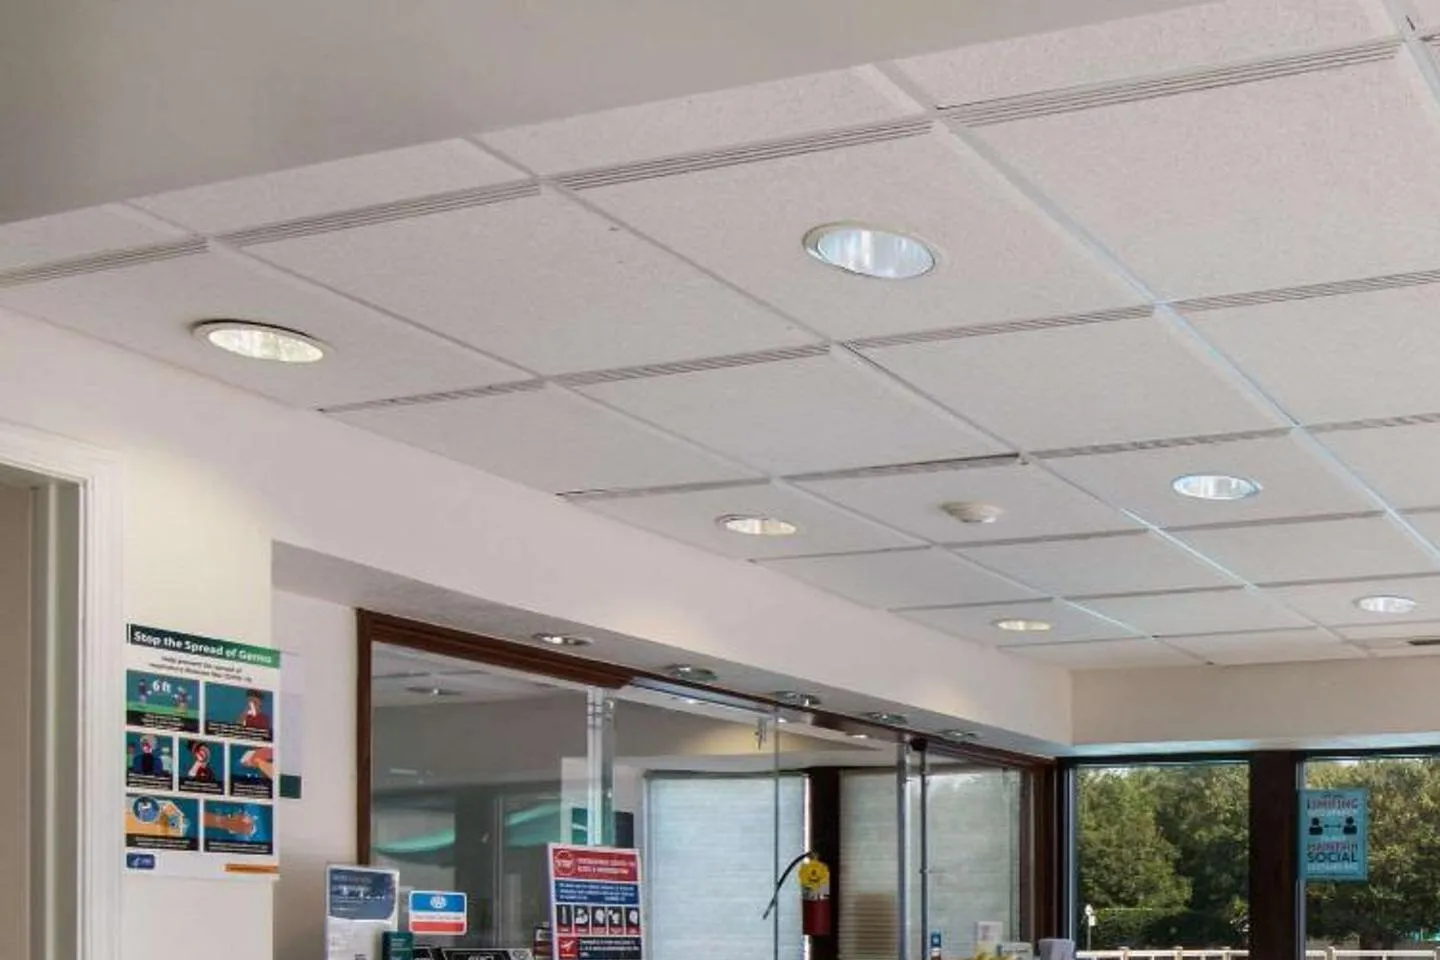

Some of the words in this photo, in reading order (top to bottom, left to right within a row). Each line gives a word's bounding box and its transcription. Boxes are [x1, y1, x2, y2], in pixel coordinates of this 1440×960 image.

[133, 632, 161, 647] Stop
[163, 637, 183, 649] the
[184, 639, 224, 656] Spread
[225, 647, 238, 657] of
[238, 650, 273, 664] Germs
[152, 680, 161, 692] 6
[1307, 852, 1358, 863] SOCIAL
